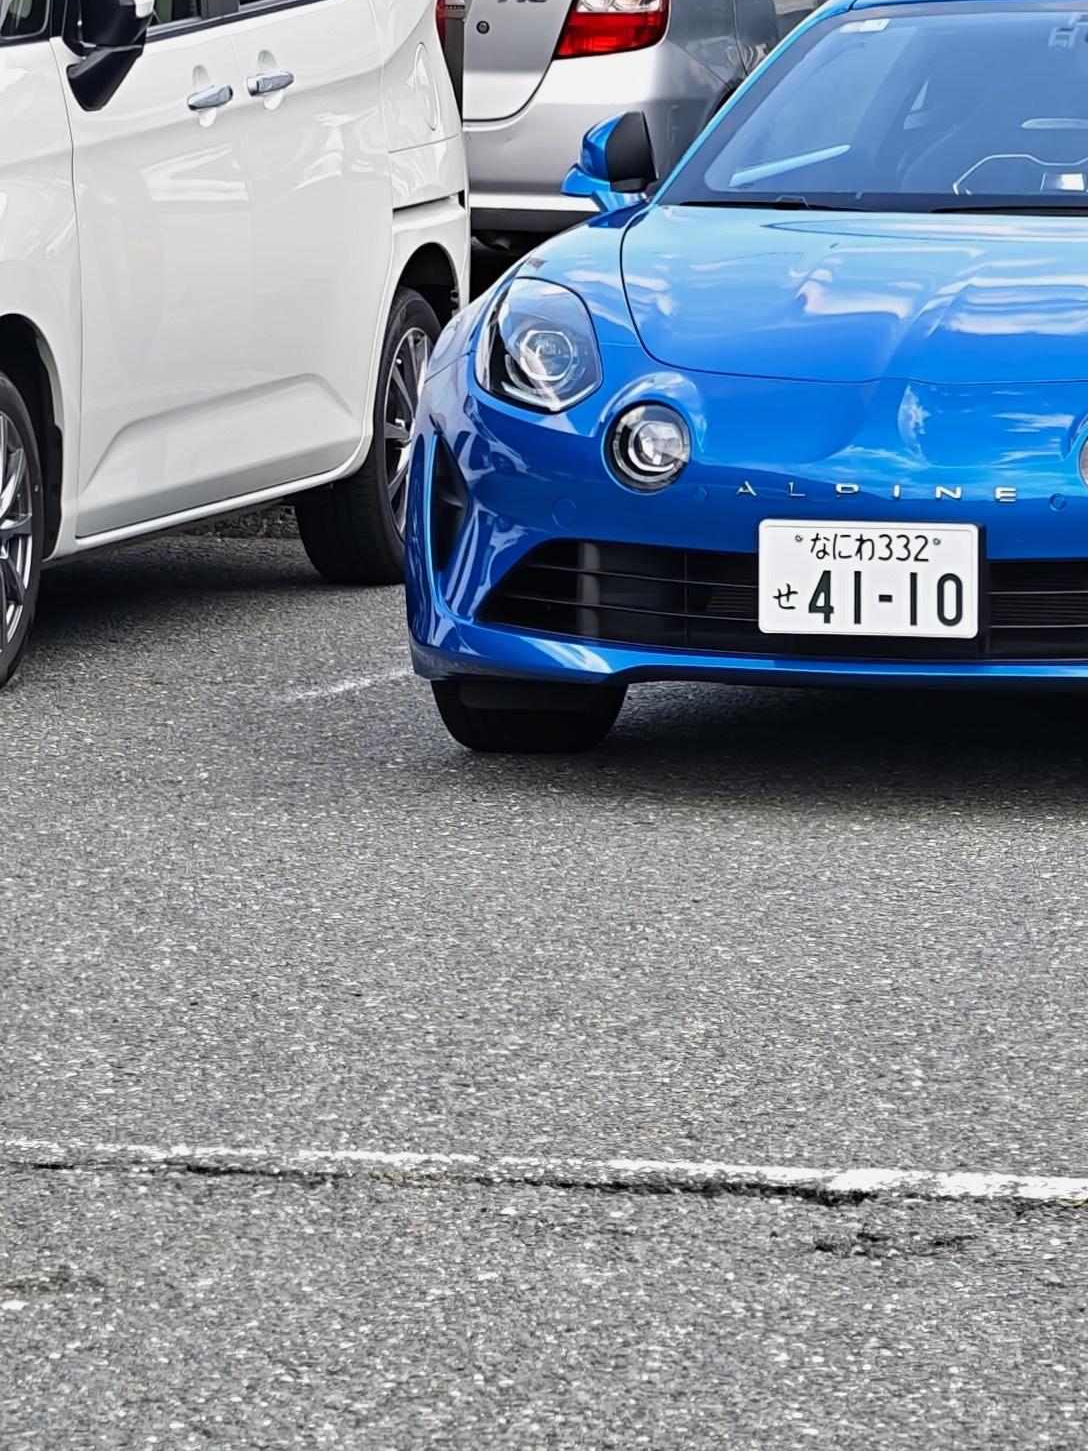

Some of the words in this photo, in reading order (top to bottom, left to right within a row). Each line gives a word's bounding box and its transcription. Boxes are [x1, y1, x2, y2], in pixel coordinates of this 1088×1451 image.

[736, 481, 1017, 503] ALPINE
[811, 532, 929, 562] なにわ332
[772, 583, 799, 610] せ
[808, 570, 963, 627] 41-10
